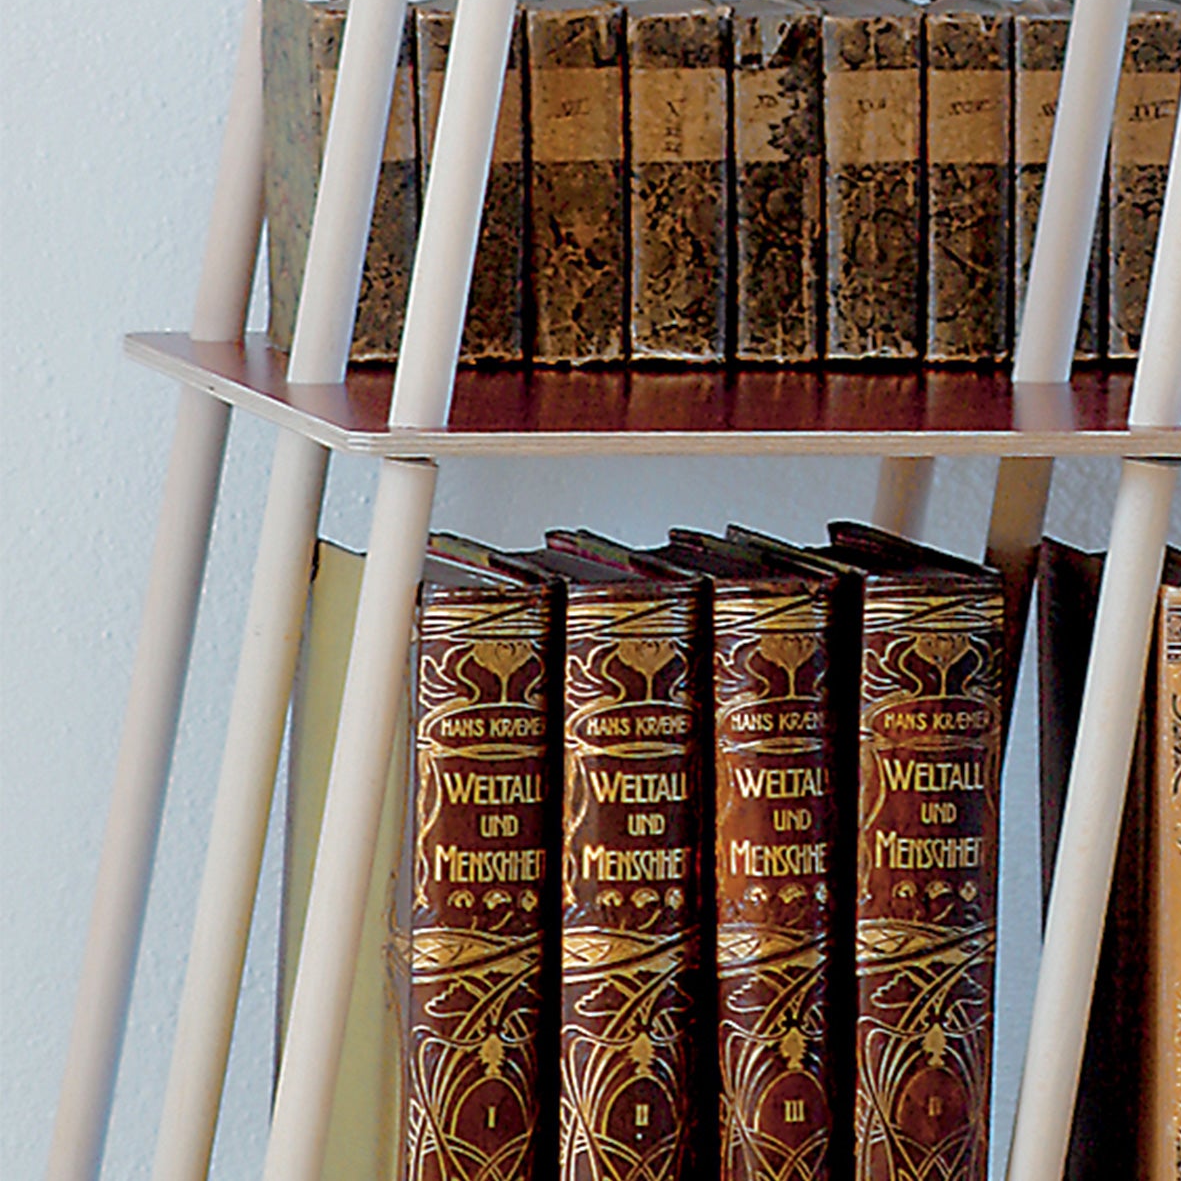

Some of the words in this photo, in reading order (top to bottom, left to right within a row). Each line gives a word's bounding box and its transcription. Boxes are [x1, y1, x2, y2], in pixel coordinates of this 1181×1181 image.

[440, 716, 485, 738] HANS
[586, 716, 631, 737] HANS
[635, 714, 692, 736] KRÆME
[730, 711, 774, 732] HANS
[884, 712, 928, 731] HANS
[590, 770, 689, 804] WELTALL
[884, 758, 985, 792] WELTALL
[442, 771, 543, 805] WELTALL
[627, 813, 666, 836] UND
[772, 808, 813, 832] UND
[921, 801, 958, 825] UND
[480, 814, 520, 838] UND
[730, 839, 828, 877] MENSCHHE
[634, 1103, 650, 1127] II
[783, 1099, 805, 1123] III
